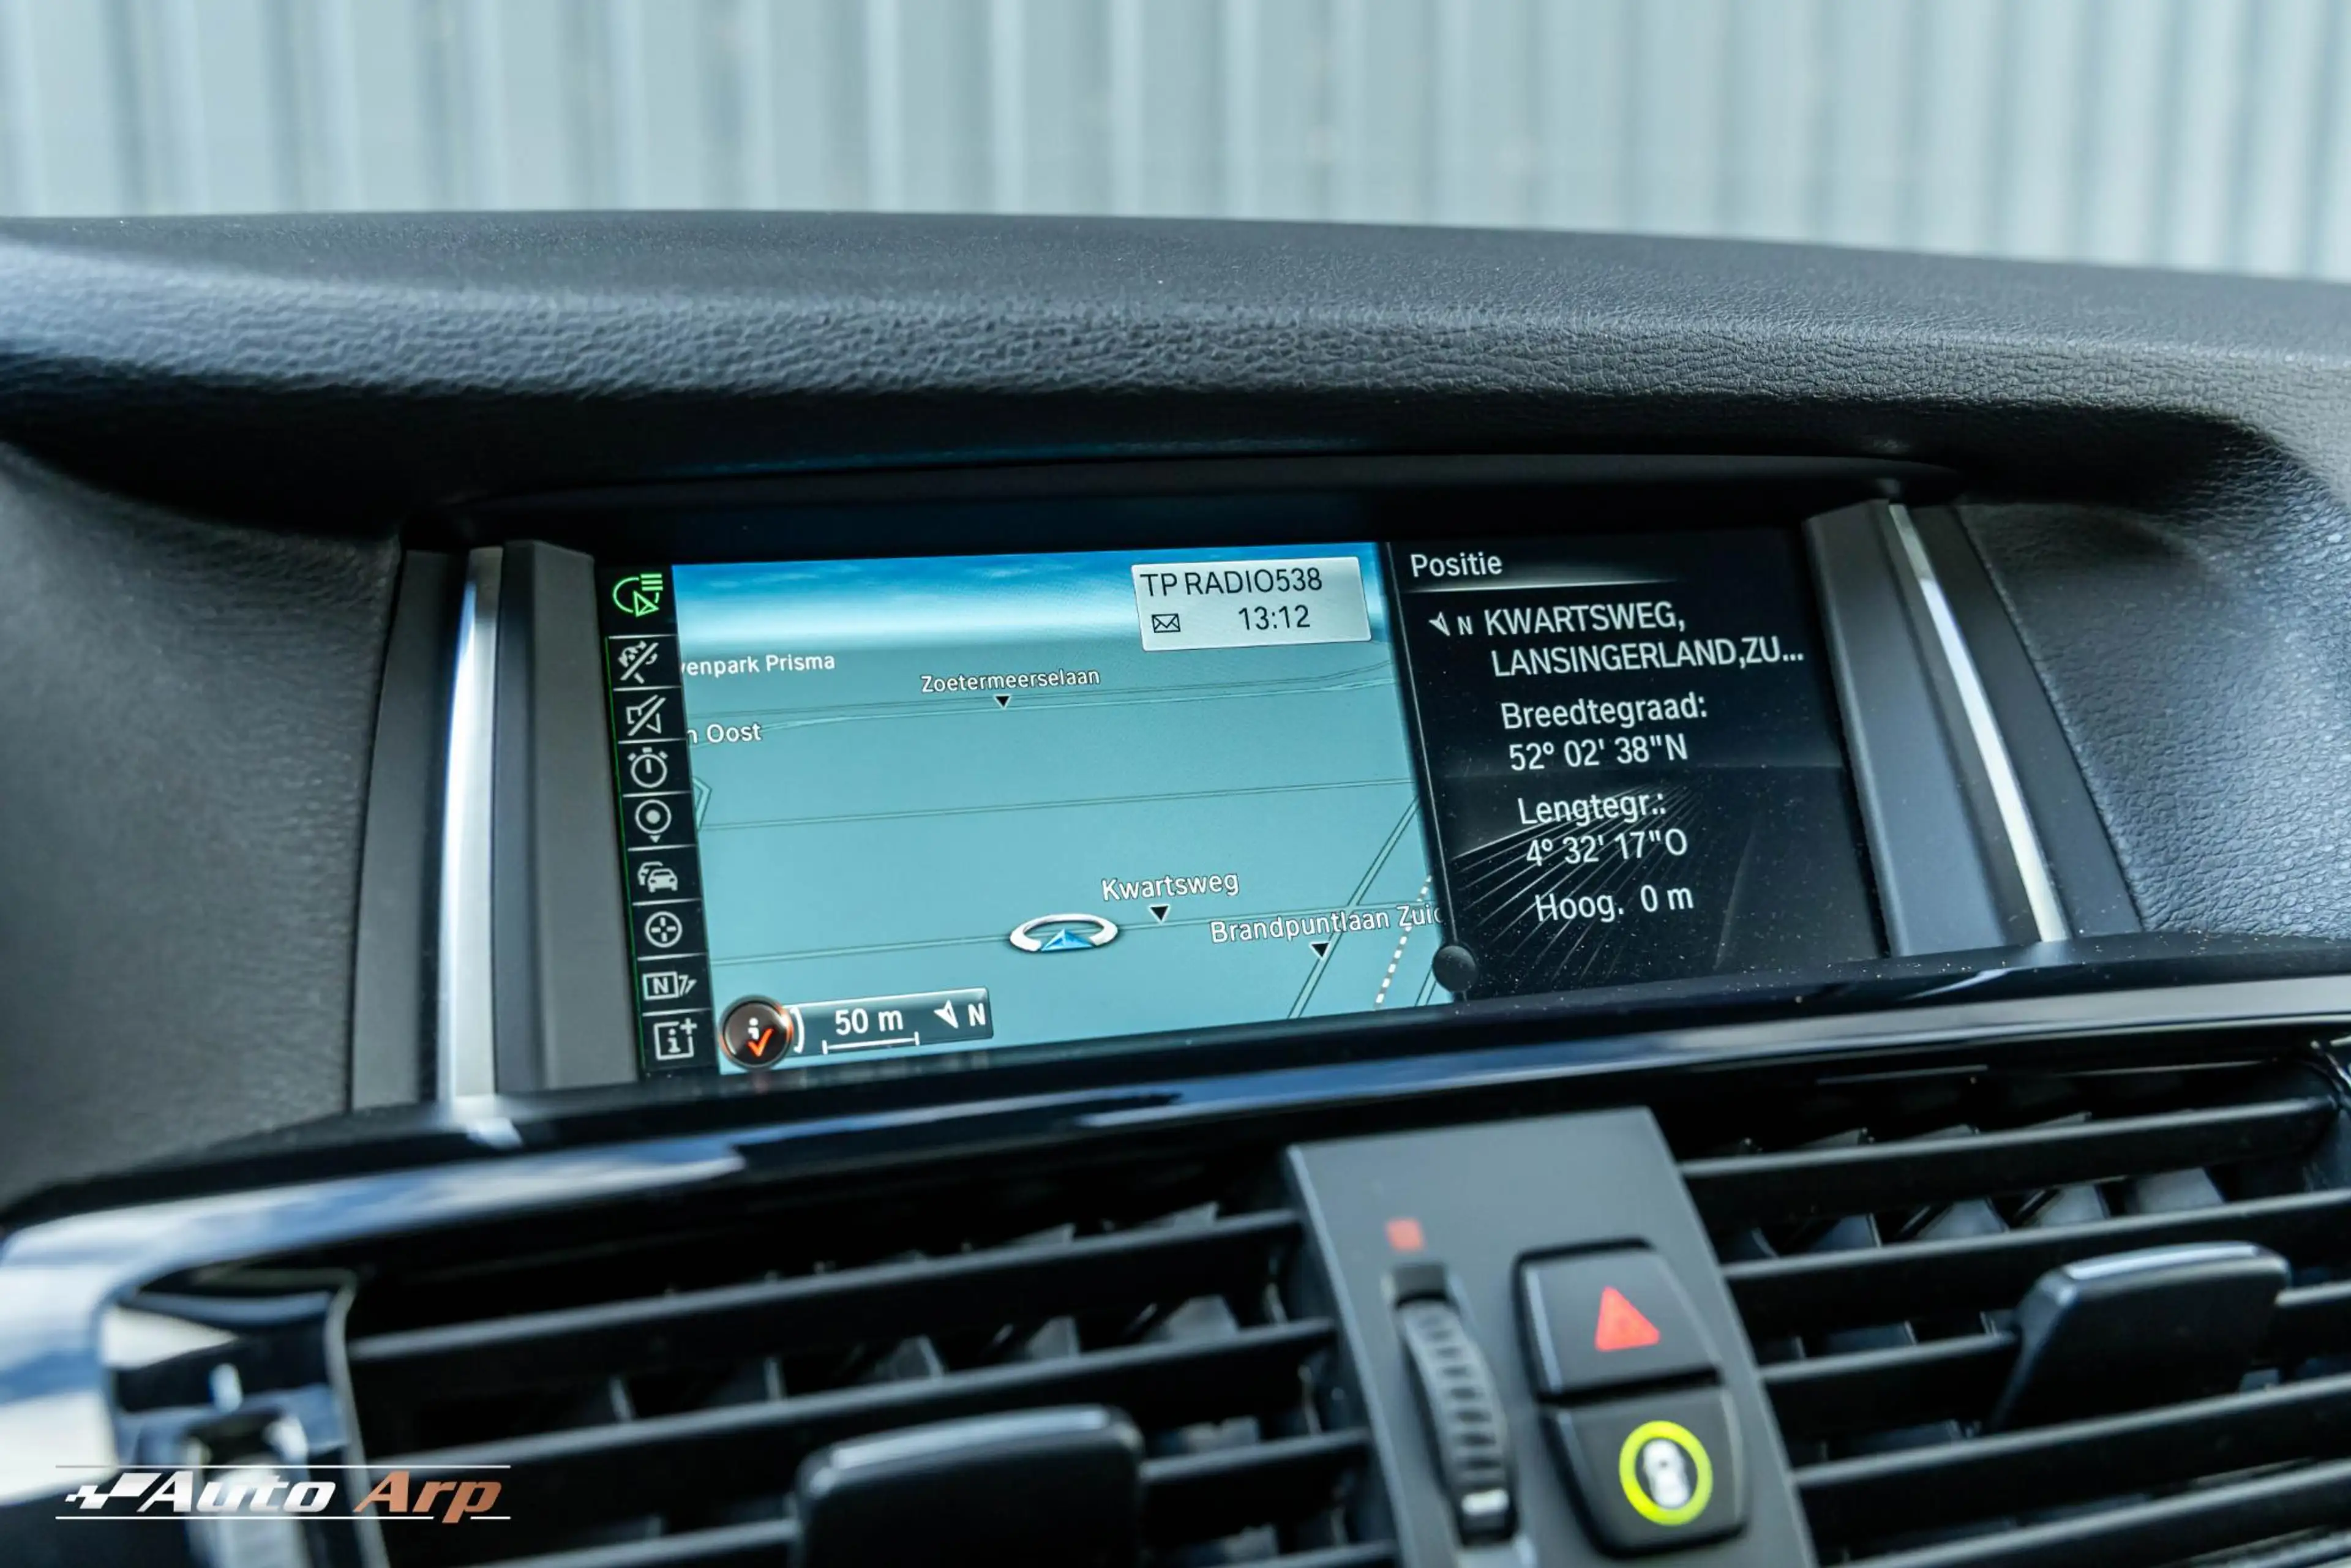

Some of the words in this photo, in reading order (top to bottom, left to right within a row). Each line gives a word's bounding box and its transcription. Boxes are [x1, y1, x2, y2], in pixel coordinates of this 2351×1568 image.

[1410, 552, 1504, 577] Positie
[1141, 572, 1177, 597] TP
[1185, 568, 1322, 595] RADIO538
[1238, 604, 1311, 630] 13:12
[1457, 616, 1473, 635] N
[1484, 602, 1686, 637] KWARTSWEG,
[765, 654, 835, 672] Prisma
[921, 669, 1100, 692] Zoetermeerselaan
[1501, 691, 1708, 729] Breedtegraad:
[707, 721, 762, 743] Oost
[1518, 793, 1667, 825] Lengtegr.:
[1102, 872, 1240, 901] Kwartsweg
[1535, 894, 1624, 922] Hoog.
[1640, 884, 1659, 912] 0
[1667, 887, 1694, 909] m
[1210, 909, 1391, 943] Brandpuntlaan
[835, 1009, 869, 1036] 50
[879, 1010, 904, 1032] m
[968, 1003, 987, 1027] N
